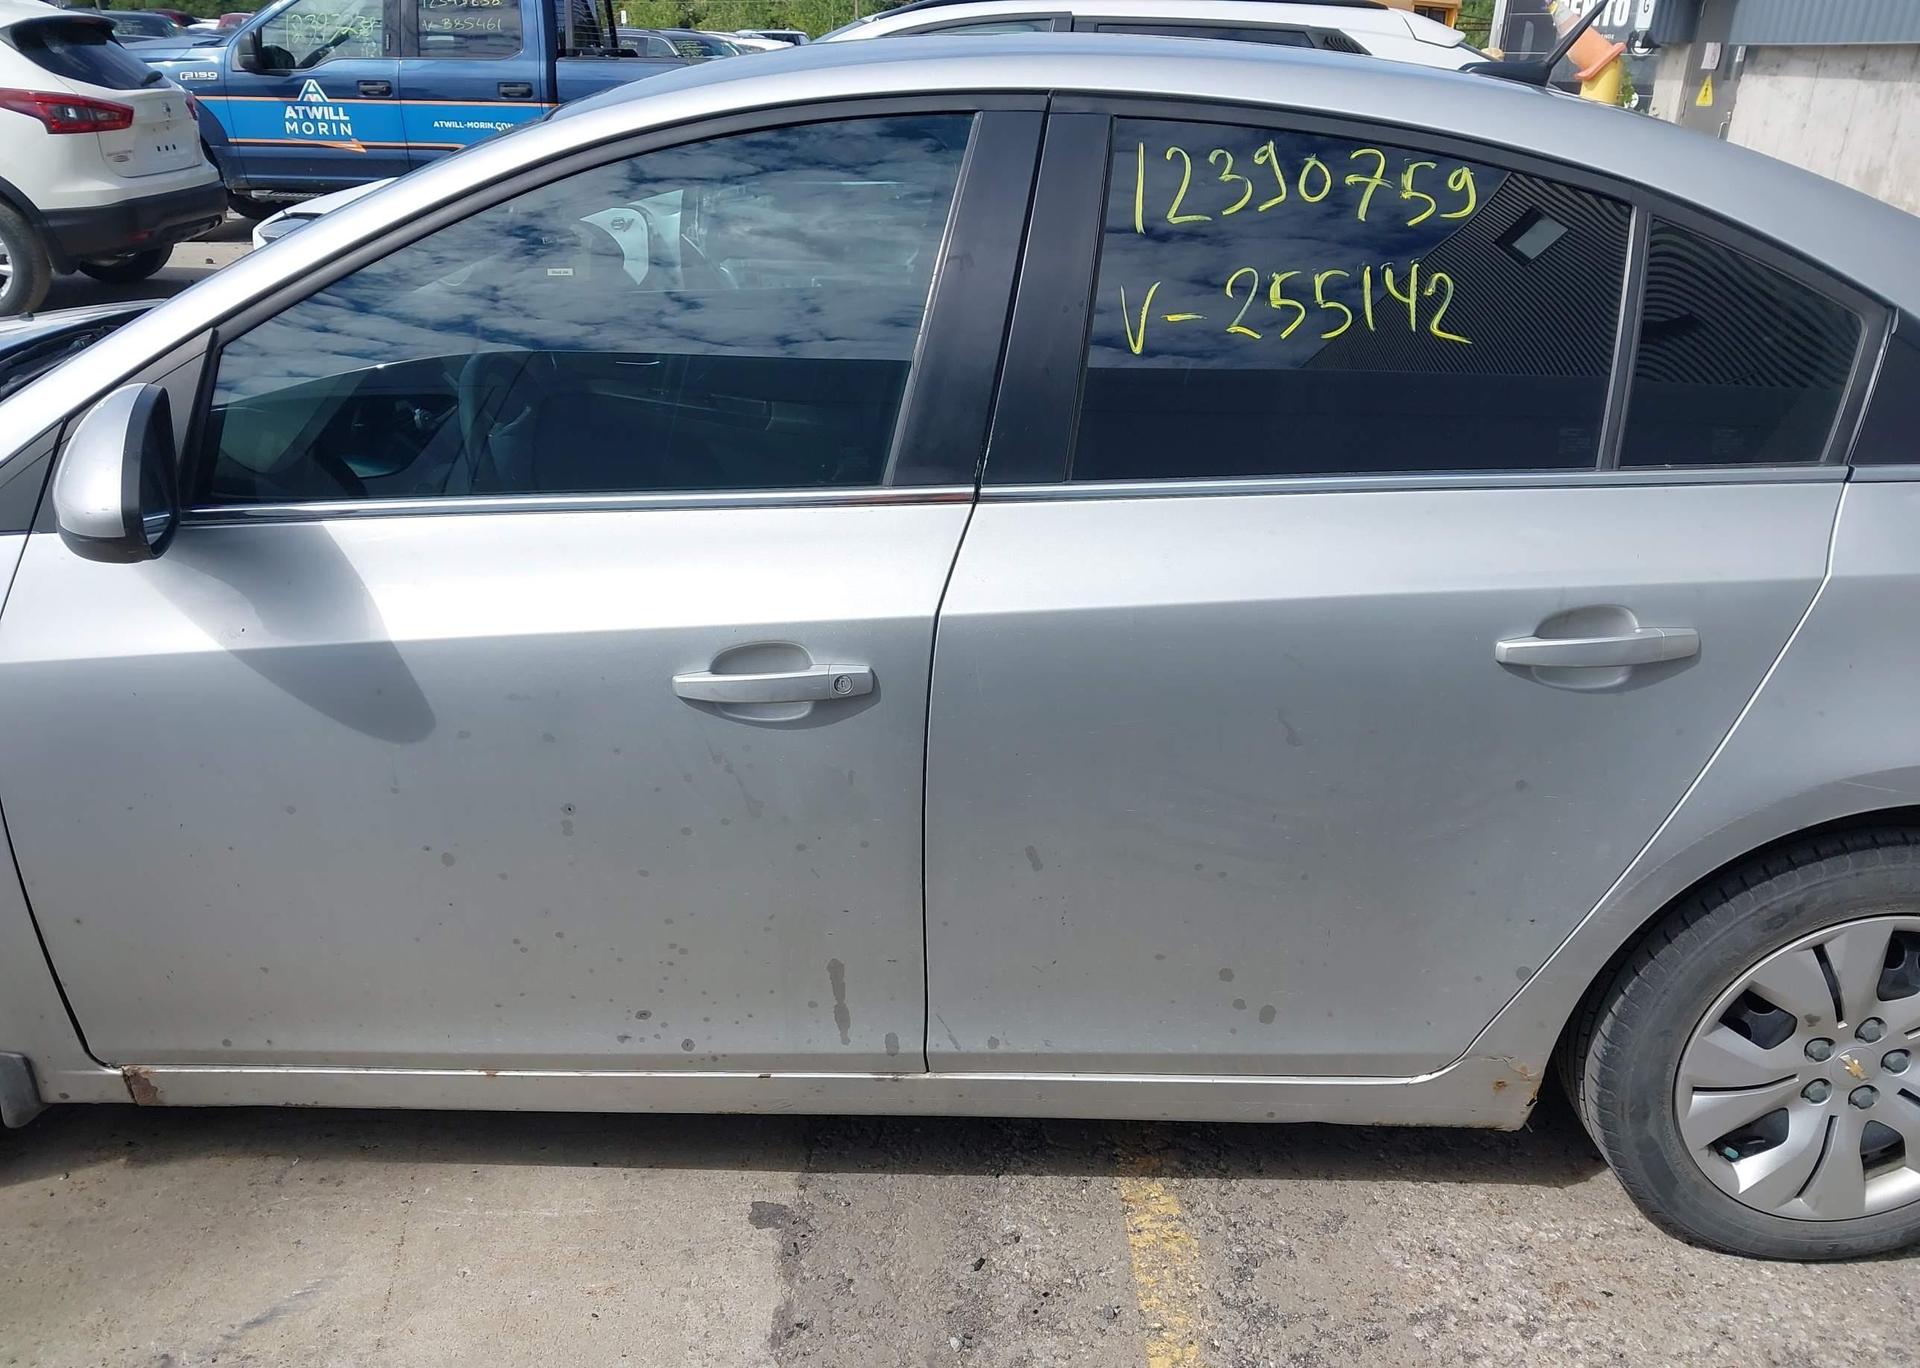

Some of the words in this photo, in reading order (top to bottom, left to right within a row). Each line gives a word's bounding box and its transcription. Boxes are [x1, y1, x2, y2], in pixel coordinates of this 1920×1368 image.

[284, 105, 350, 121] ATWILL
[285, 121, 353, 136] MORIN
[1134, 140, 1478, 235] 12390759
